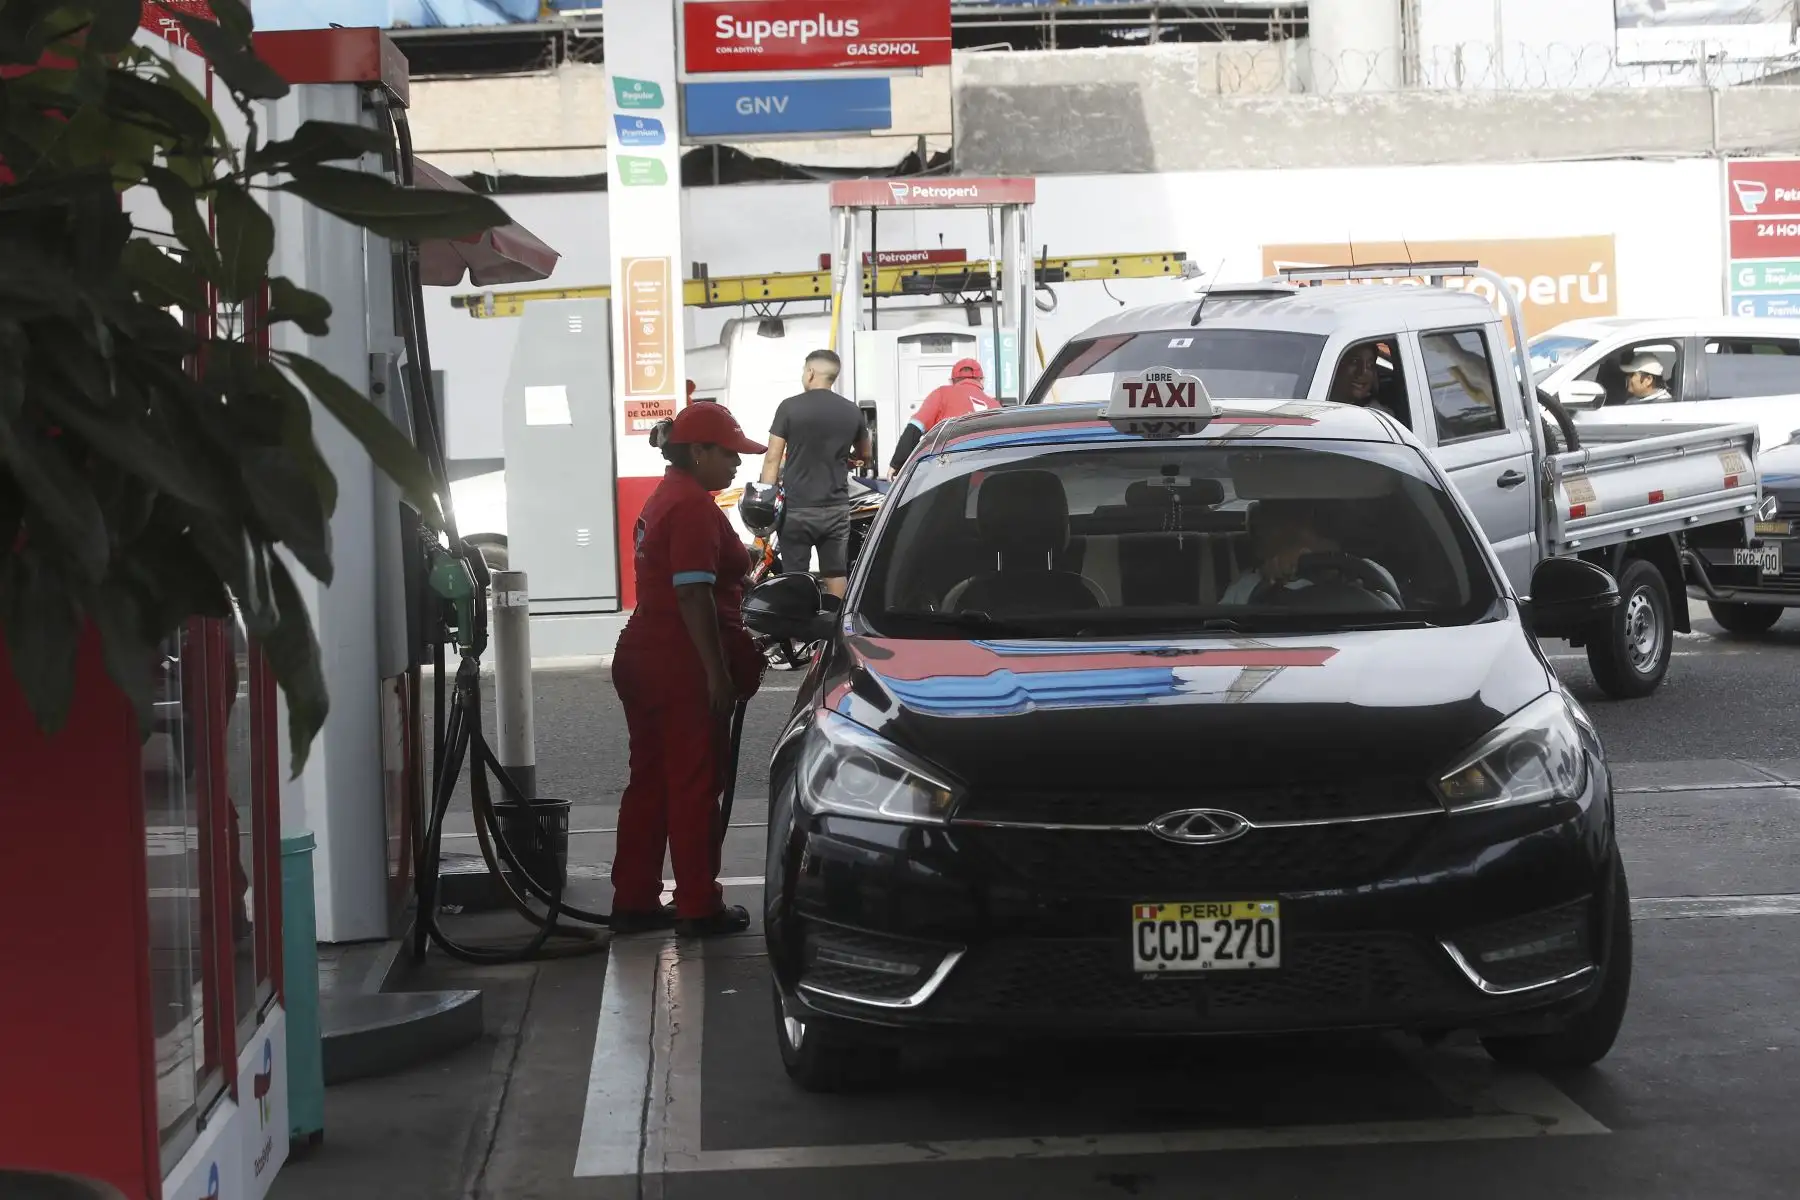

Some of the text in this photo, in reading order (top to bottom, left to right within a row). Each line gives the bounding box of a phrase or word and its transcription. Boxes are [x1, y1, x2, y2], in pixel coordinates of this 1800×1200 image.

[715, 13, 859, 44] Superplus
[716, 46, 764, 54] CON ADITIVO
[846, 43, 920, 56] GASOHOL
[736, 96, 790, 115] GNV
[622, 129, 659, 137] Premium
[912, 185, 978, 199] Petroperú
[1757, 223, 1800, 237] 24 HO
[878, 250, 929, 262] Petroperú
[1738, 267, 1756, 288] G
[1146, 373, 1172, 381] LIBRE
[1122, 382, 1196, 408] TAXI
[640, 401, 660, 409] TIPO
[628, 409, 673, 418] DE CAMBIO
[1180, 904, 1232, 919] PERU
[1138, 918, 1275, 961] CCD-270
